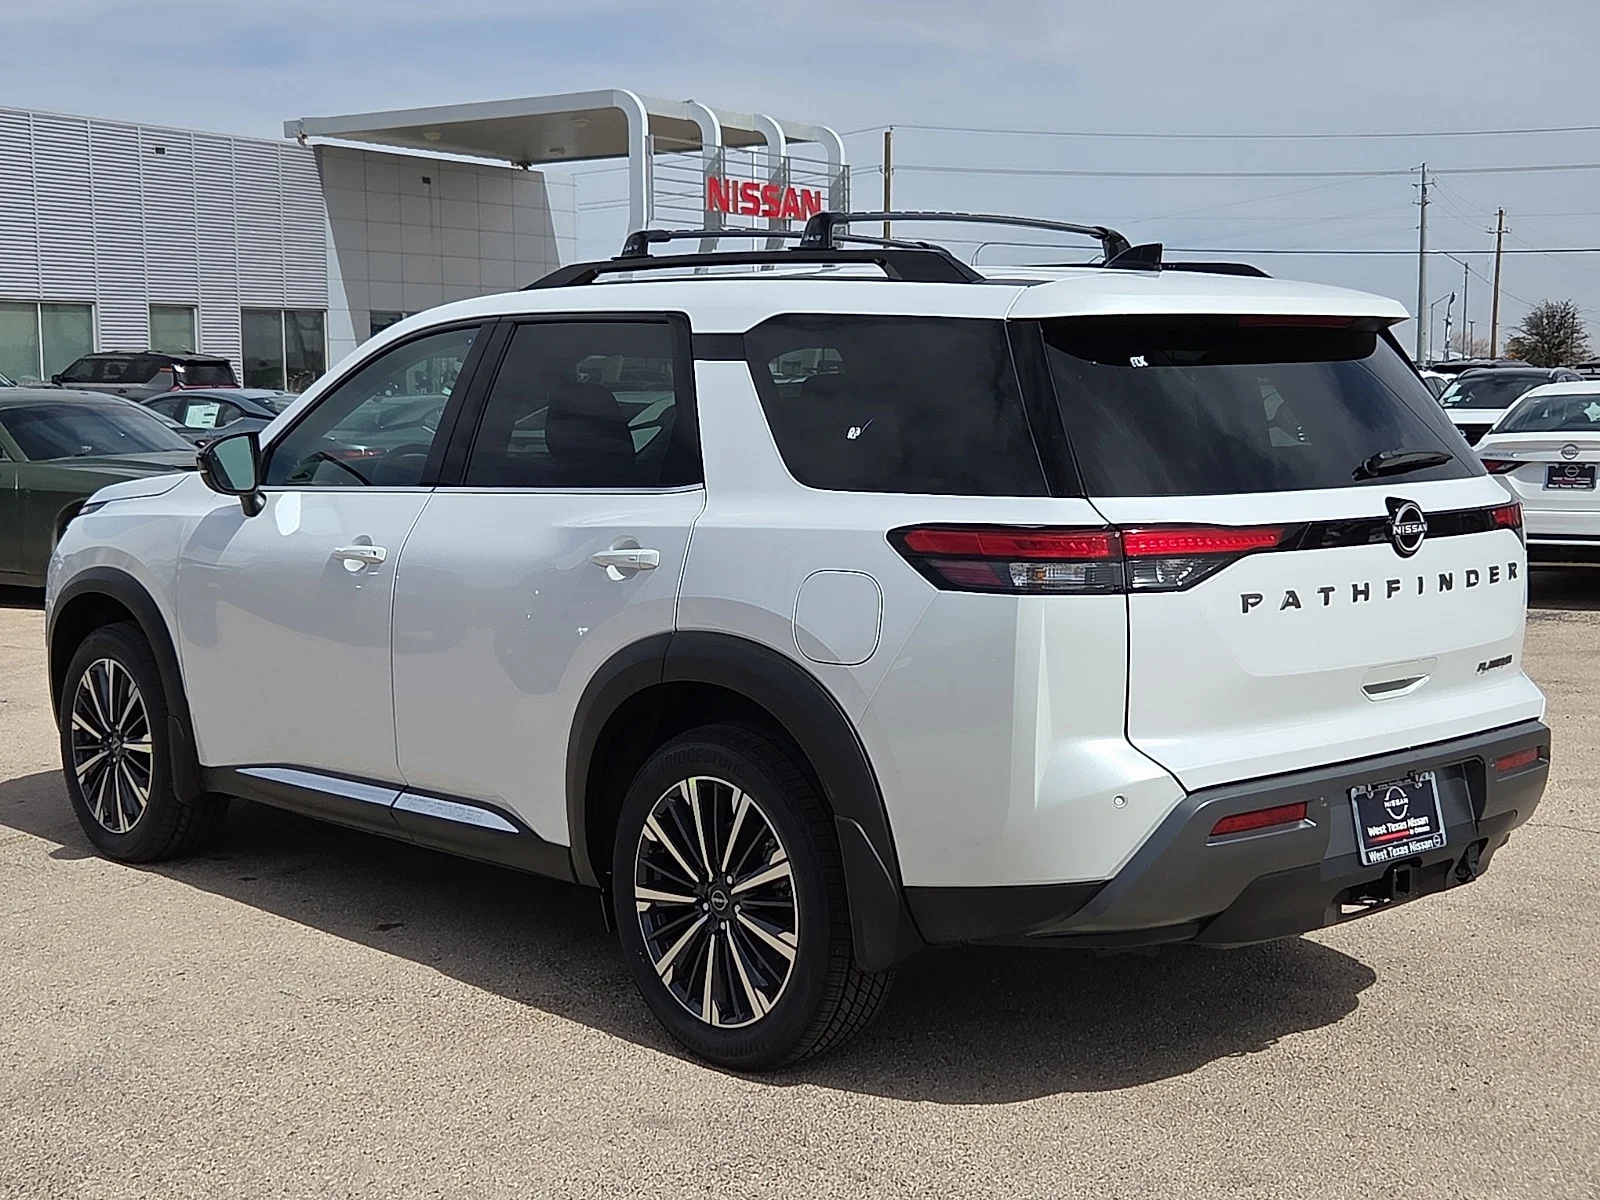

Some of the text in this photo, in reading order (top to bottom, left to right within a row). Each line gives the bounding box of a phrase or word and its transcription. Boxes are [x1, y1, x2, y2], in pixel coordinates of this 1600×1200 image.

[706, 176, 822, 221] NISSAN
[1392, 522, 1428, 536] NISSAN
[1240, 561, 1519, 613] PATHFINDER
[1367, 824, 1387, 837] West
[1388, 821, 1407, 832] Texas
[1407, 816, 1429, 828] Nissan
[1368, 839, 1434, 863] West Texas Nissan
